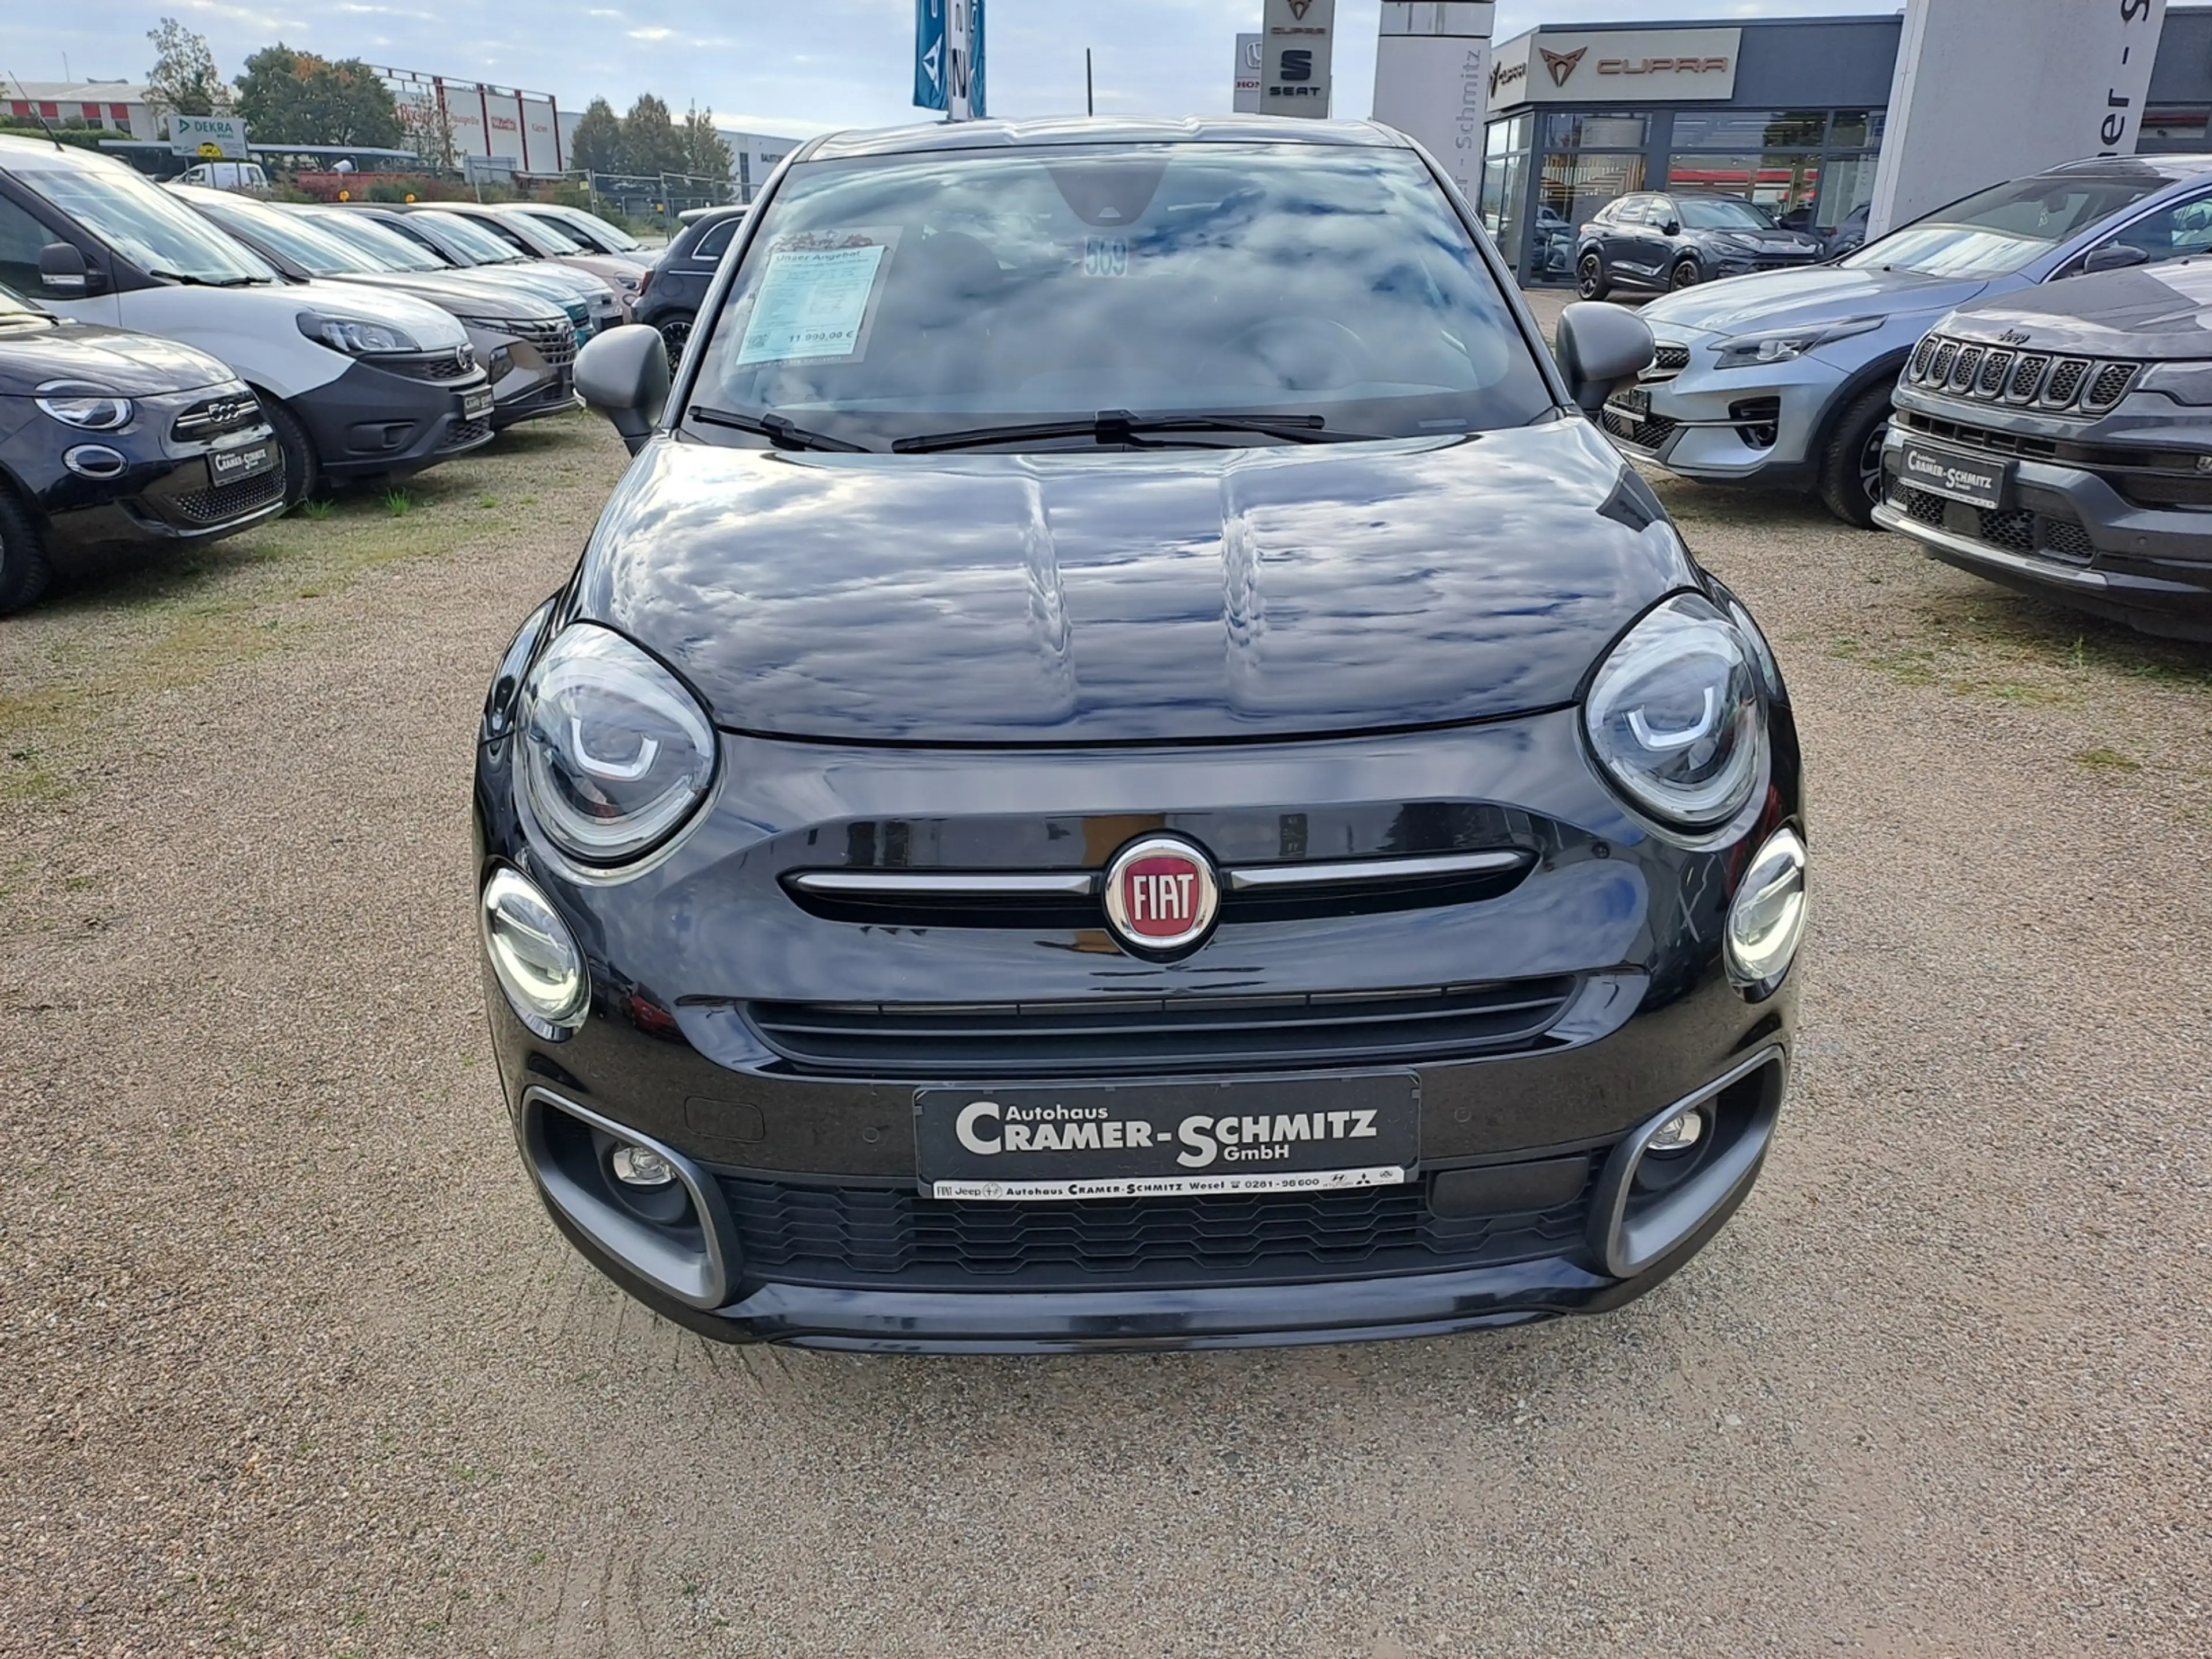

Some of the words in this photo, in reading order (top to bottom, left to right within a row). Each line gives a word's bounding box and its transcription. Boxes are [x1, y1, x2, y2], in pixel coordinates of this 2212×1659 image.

[1271, 26, 1326, 35] CUPRA
[1597, 57, 1728, 74] CUPRA
[1269, 86, 1320, 96] SEAT
[1456, 50, 1480, 149] Schmitz
[195, 121, 233, 133] DEKRA
[813, 251, 860, 260] Angebot
[1133, 874, 1194, 920] FIAT
[1006, 1104, 1108, 1121] Autohaus
[956, 1101, 1377, 1168] CRAMER-SCHMITZ
[1224, 1145, 1289, 1161] GmbH
[955, 1187, 981, 1197] Jeep
[1006, 1187, 1063, 1196] Autohaus
[1068, 1183, 1183, 1195] CRAMER-SCHMITZ
[1190, 1180, 1224, 1190] Wesel
